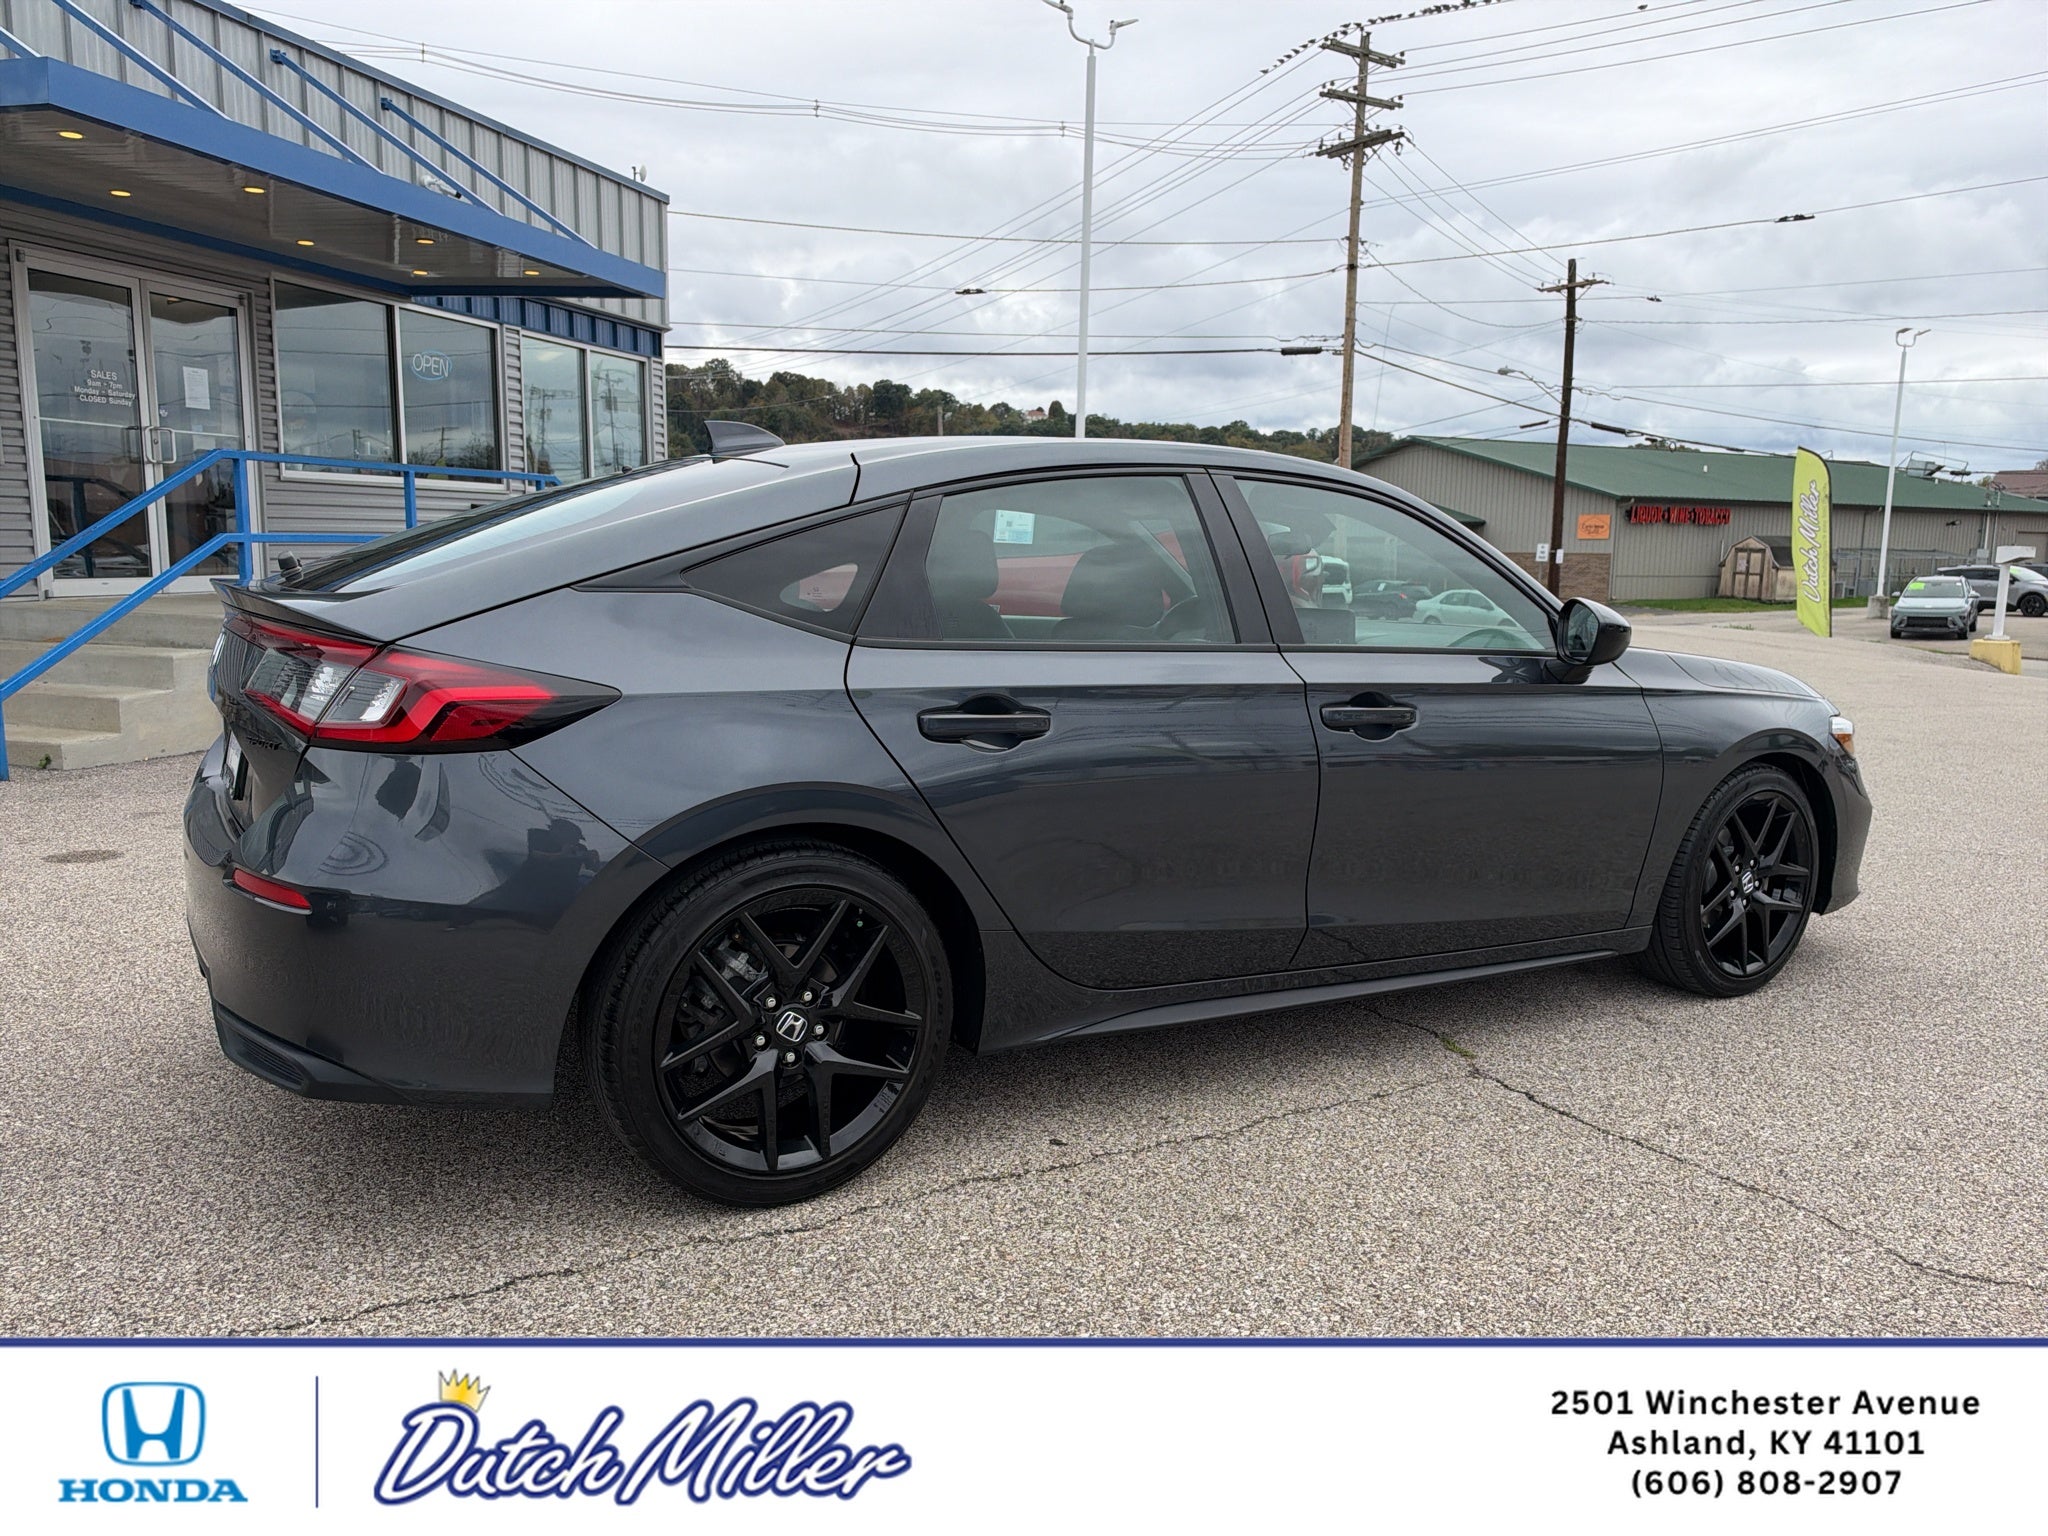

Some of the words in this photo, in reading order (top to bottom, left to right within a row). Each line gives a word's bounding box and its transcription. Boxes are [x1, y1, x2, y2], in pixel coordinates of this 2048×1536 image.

[412, 353, 449, 378] OPEN
[90, 369, 118, 381] SALES
[74, 386, 99, 395] Monday
[108, 389, 136, 400] Saturday
[80, 394, 107, 404] CLOSED
[108, 397, 132, 407] Sunday
[1630, 505, 1662, 525] LIQUOR
[1669, 505, 1691, 525] WINE
[1695, 507, 1732, 526] TOBACCO
[1798, 480, 1821, 548] Miller
